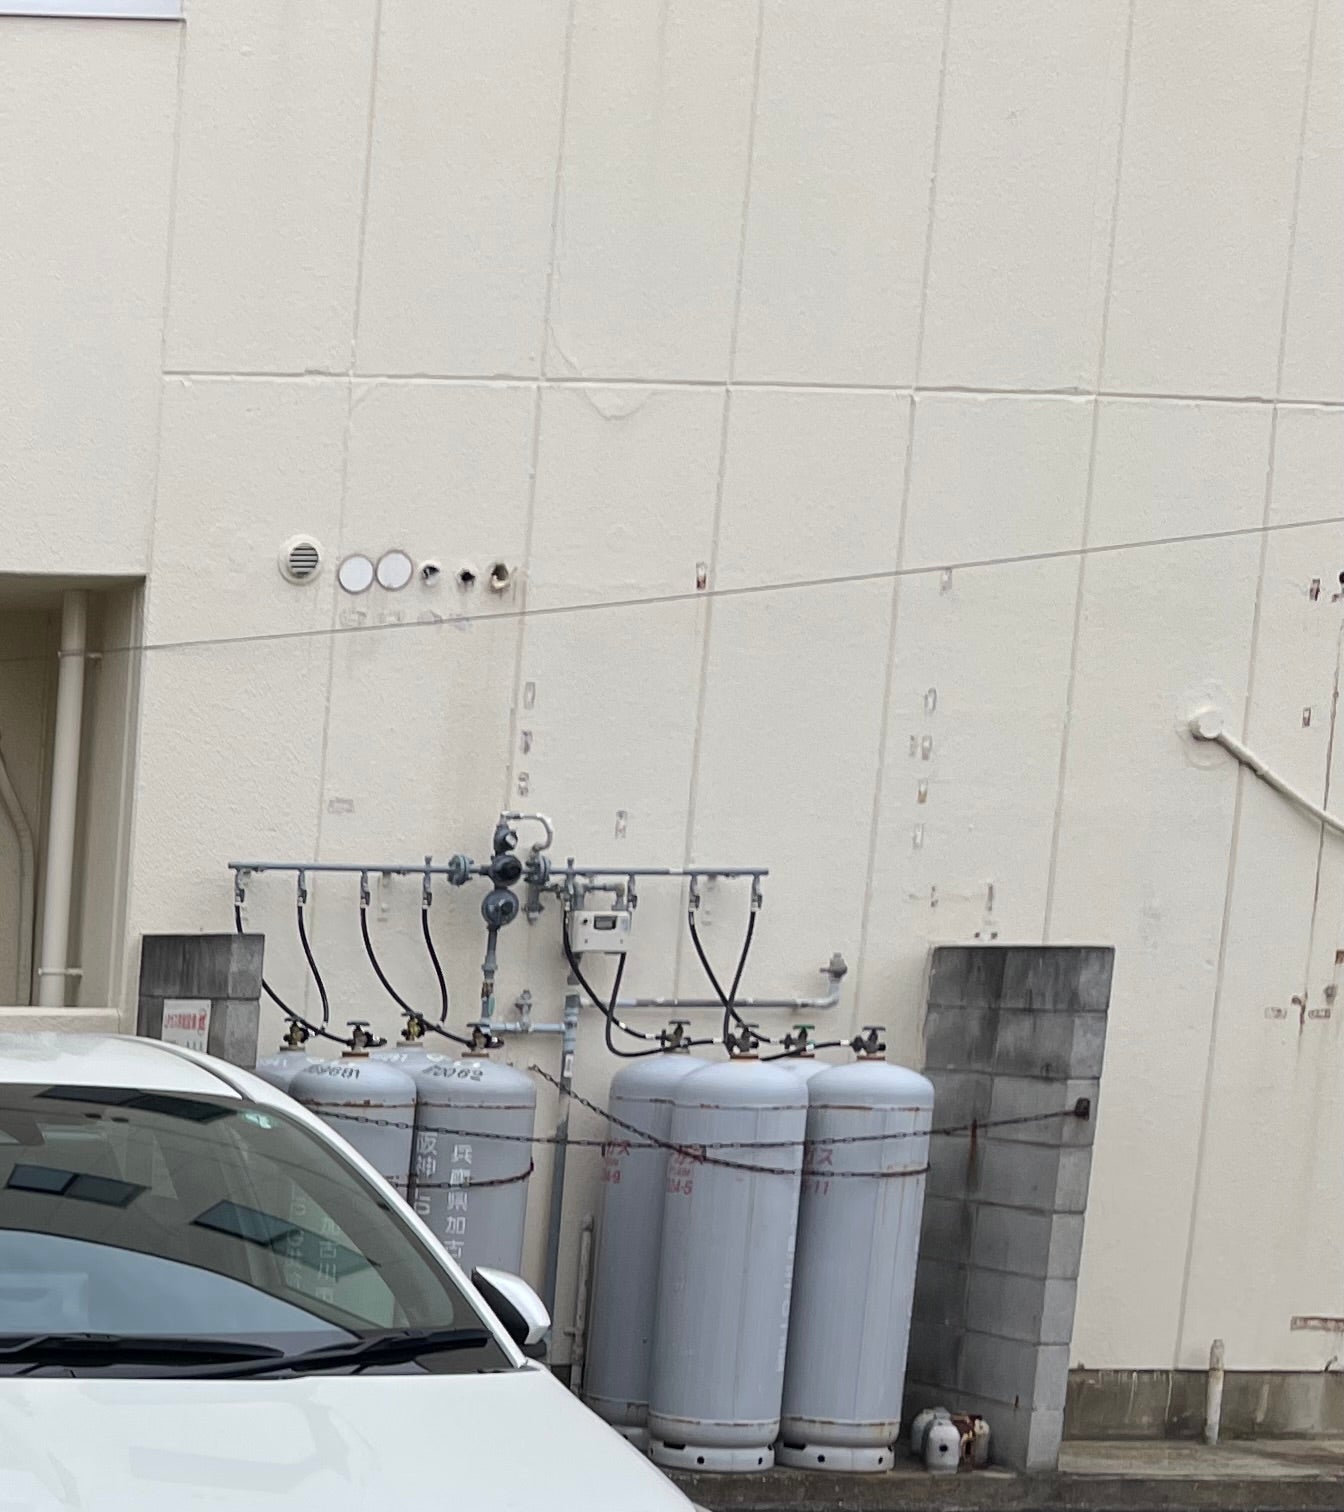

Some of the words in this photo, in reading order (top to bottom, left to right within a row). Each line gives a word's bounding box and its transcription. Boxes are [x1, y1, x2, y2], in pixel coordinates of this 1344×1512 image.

[443, 1144, 473, 1259] 兵庫県加古
